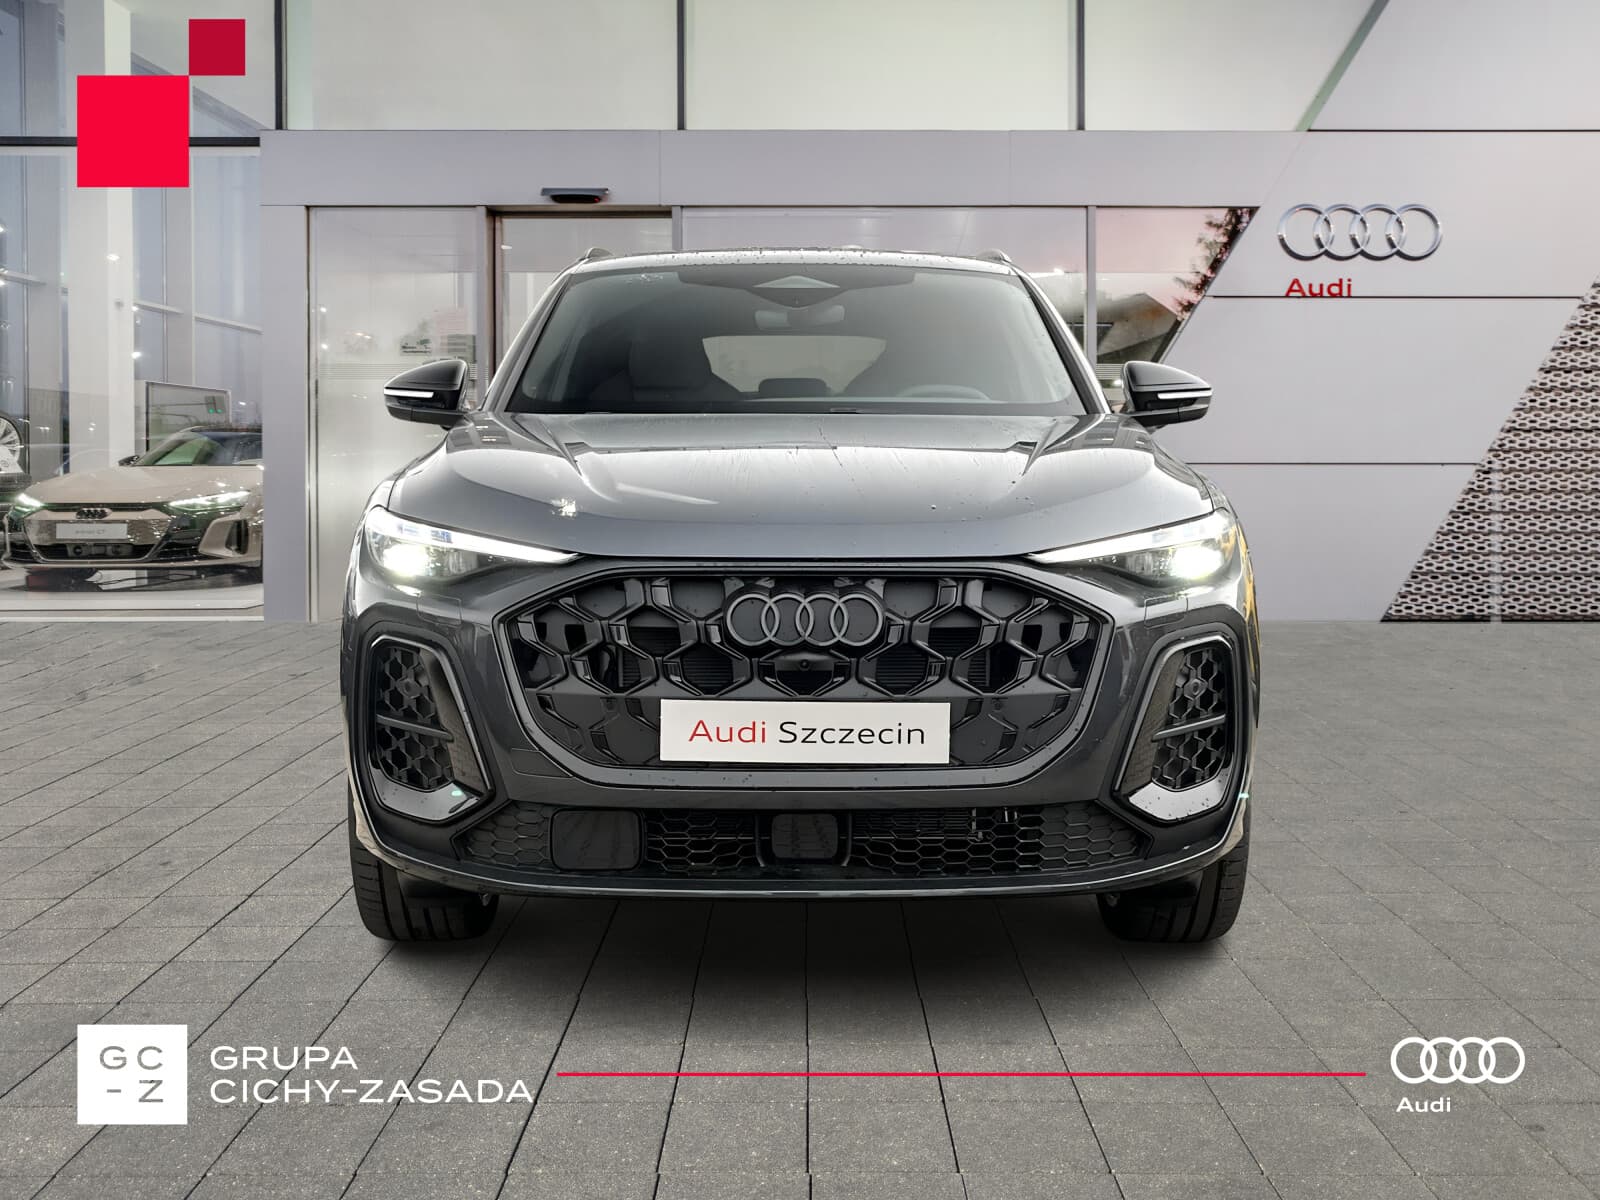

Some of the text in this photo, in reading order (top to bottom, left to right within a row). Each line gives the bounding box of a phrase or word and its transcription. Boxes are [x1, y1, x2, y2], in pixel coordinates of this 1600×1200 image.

[1285, 277, 1352, 298] Audi
[689, 720, 925, 745] Audi Szczecin
